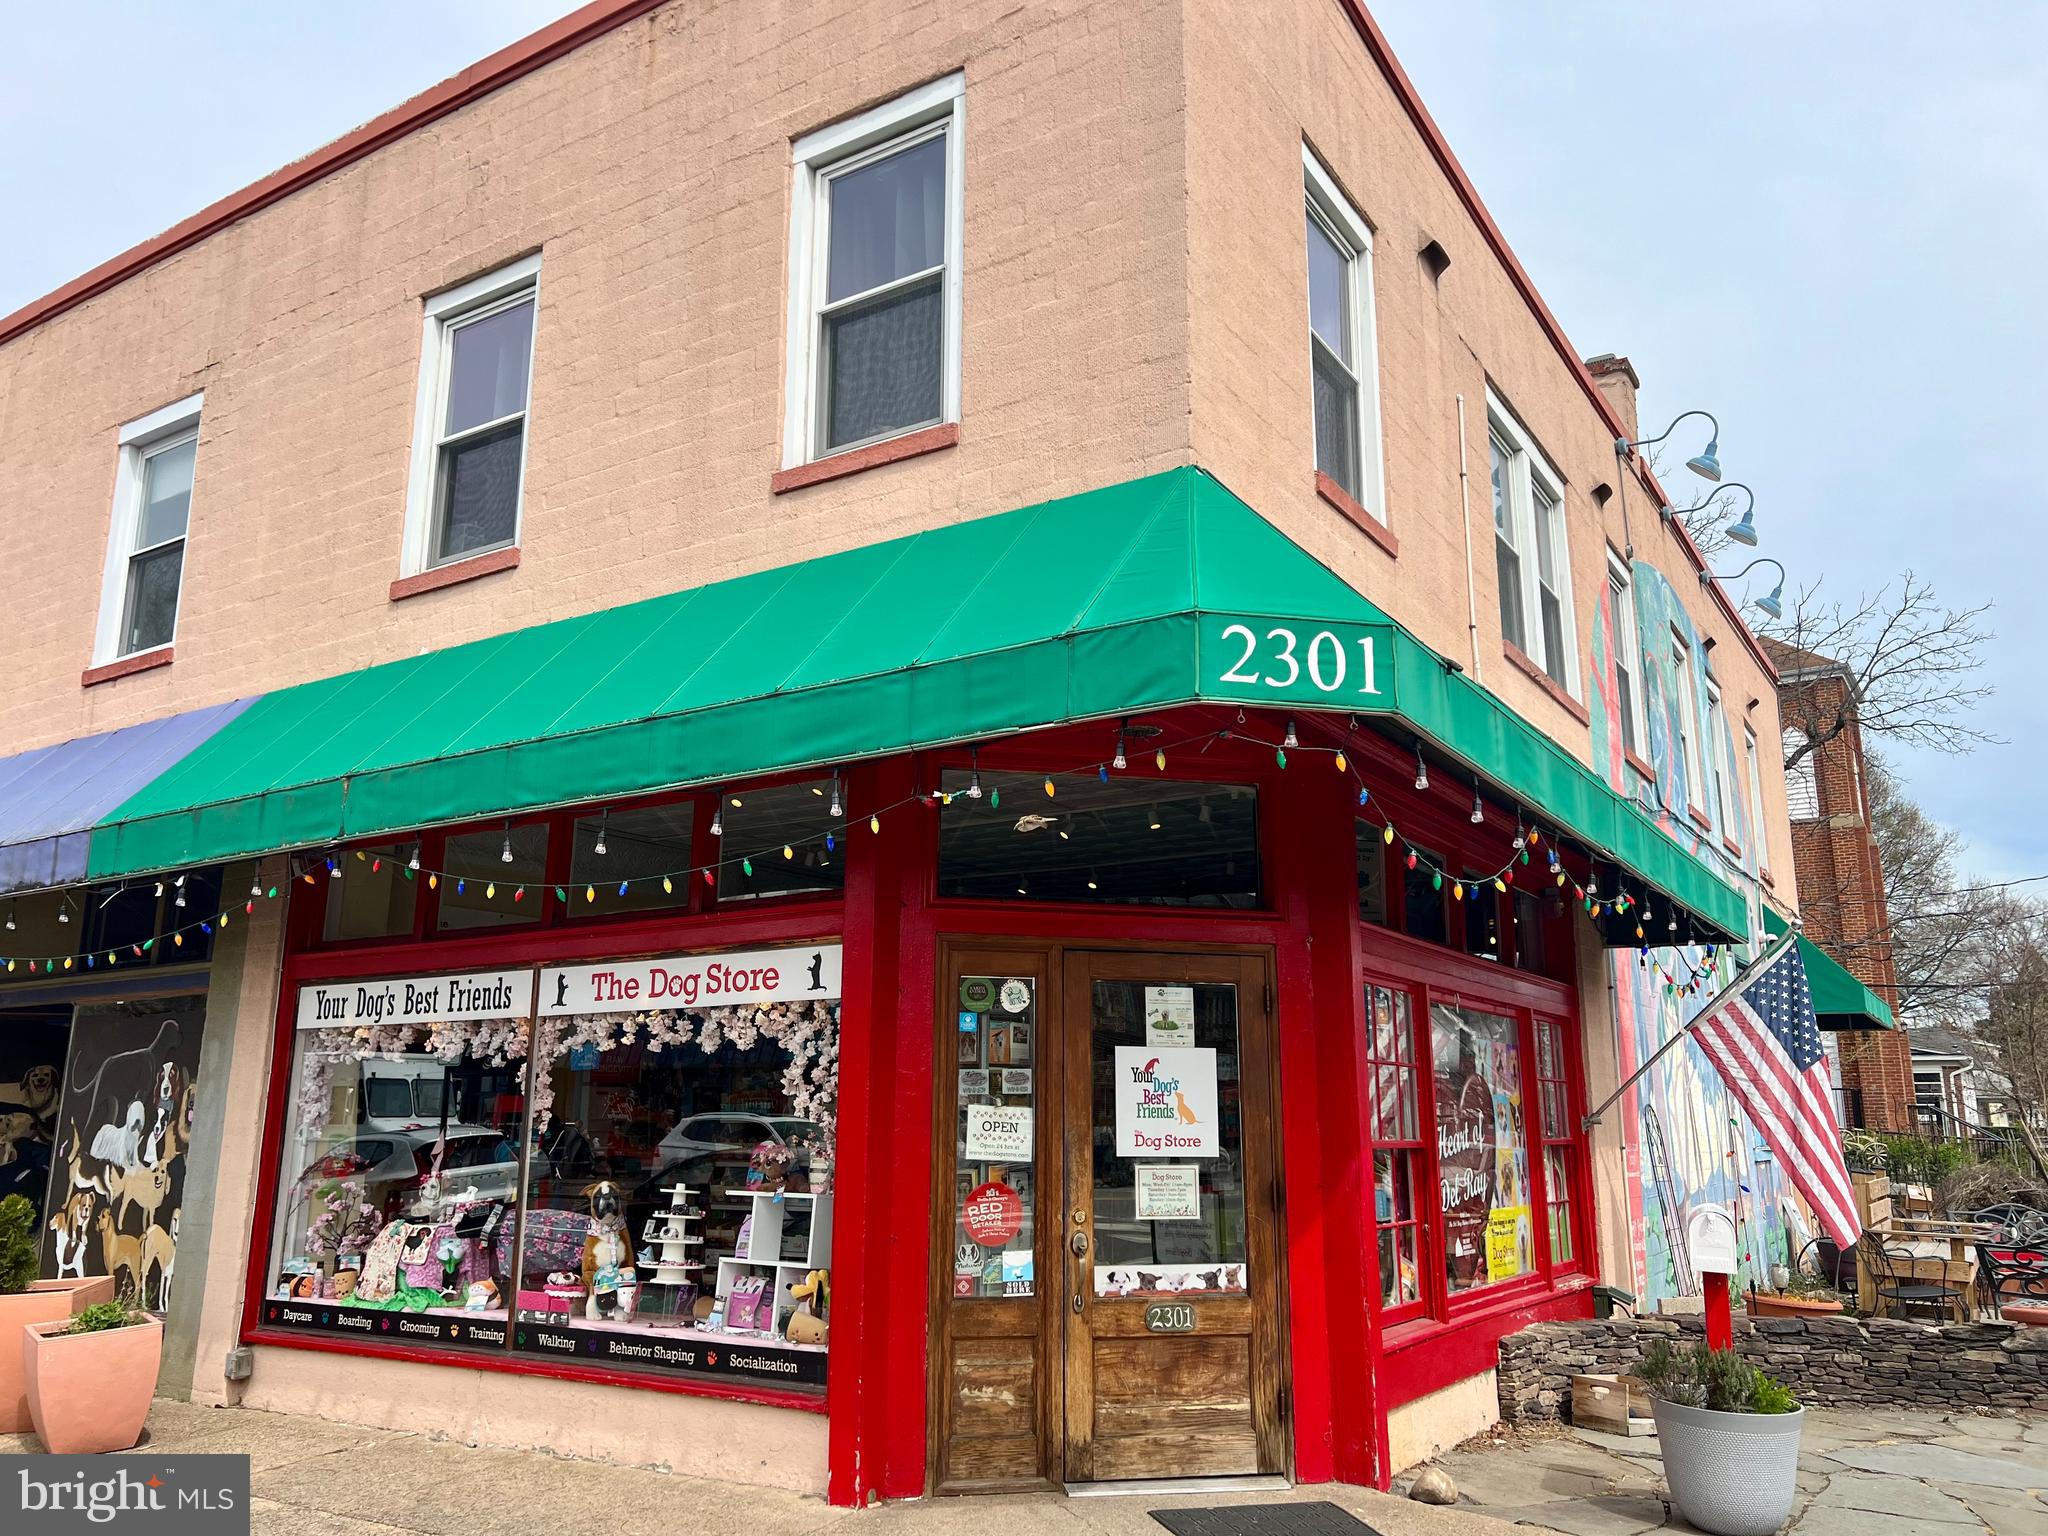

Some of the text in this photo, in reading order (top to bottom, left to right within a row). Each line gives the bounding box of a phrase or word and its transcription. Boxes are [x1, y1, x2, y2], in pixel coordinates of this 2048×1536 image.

[1219, 624, 1382, 694] 2301
[592, 963, 780, 1003] The Dog Store
[316, 978, 512, 1020] Your Dog's Best Friends
[1131, 1066, 1155, 1083] Your
[1153, 1077, 1180, 1097] Dog's
[1143, 1088, 1165, 1105] Best
[1136, 1102, 1175, 1119] Friends
[982, 1120, 1019, 1133] OPEN
[1134, 1134, 1202, 1151] Dog Store
[1438, 1121, 1470, 1160] Heart
[1152, 1173, 1165, 1182] Dog
[1441, 1167, 1488, 1212] Del Ray
[967, 1202, 1003, 1217] RED
[970, 1213, 1002, 1224] DOOR
[283, 1309, 313, 1322] Daycare
[338, 1314, 372, 1329] Boarding
[1151, 1306, 1193, 1328] 2301
[400, 1320, 440, 1336] Grooming
[469, 1327, 505, 1343] Training
[538, 1333, 576, 1351] Walking
[609, 1341, 695, 1365] Behavior Shaping
[730, 1354, 798, 1374] Socialization
